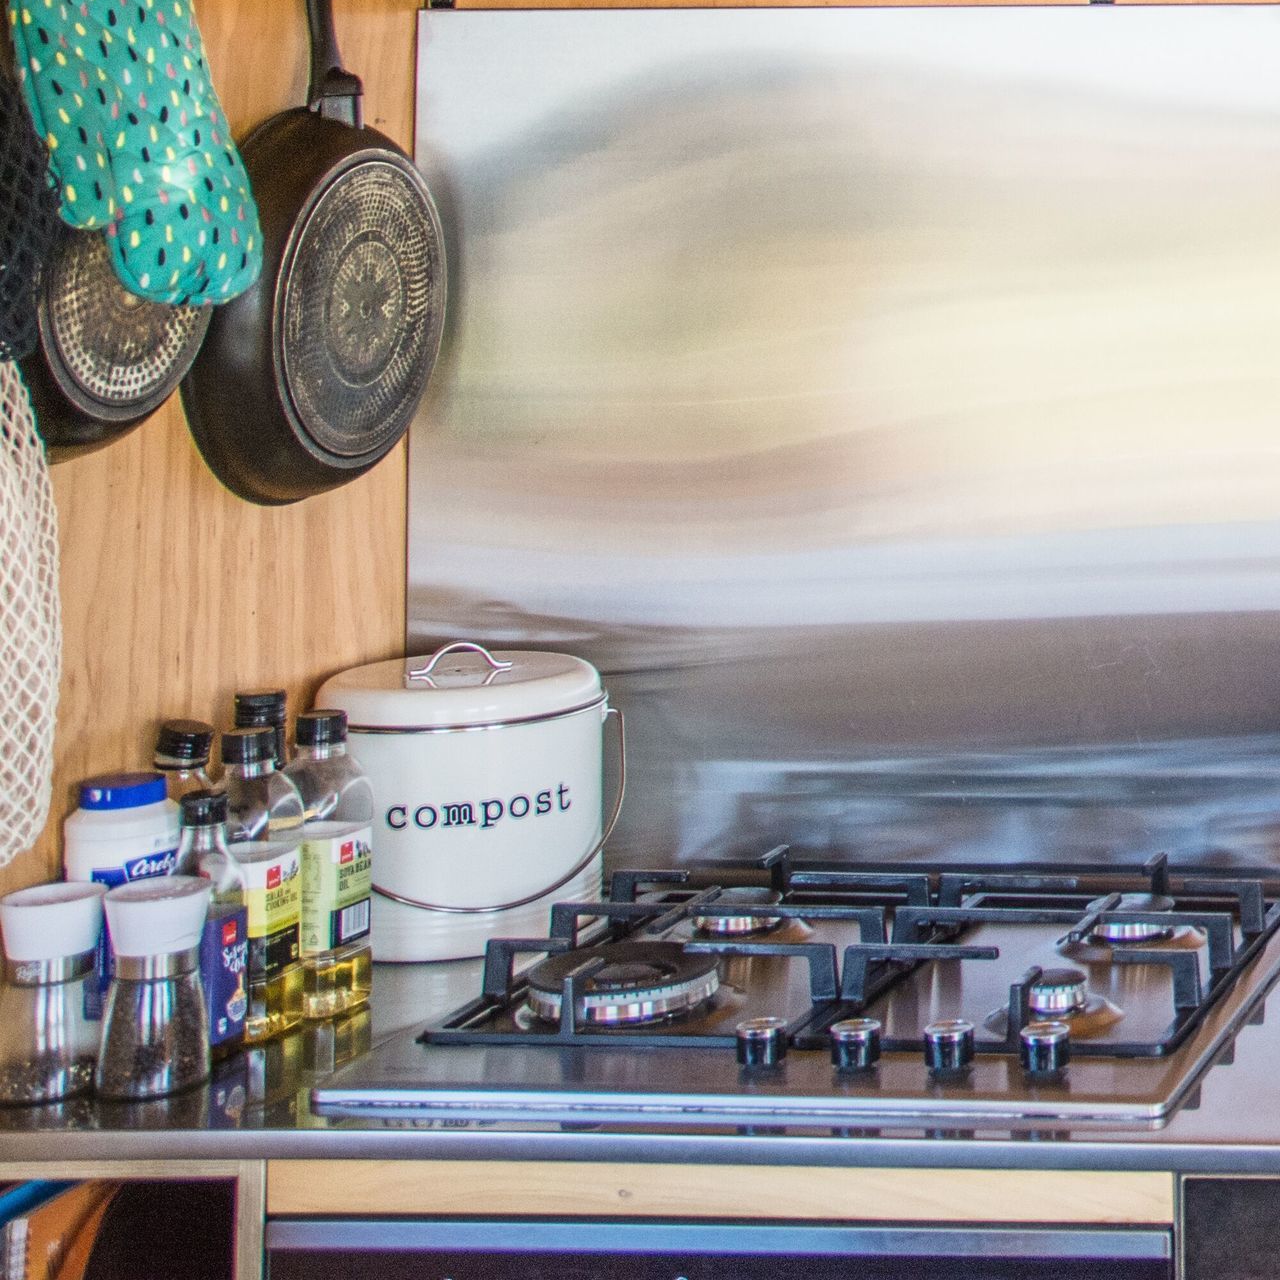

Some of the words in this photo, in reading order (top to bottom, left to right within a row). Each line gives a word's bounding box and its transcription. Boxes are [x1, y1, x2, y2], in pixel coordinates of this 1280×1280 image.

[386, 781, 572, 830] compost
[339, 865, 355, 879] SOYA
[355, 858, 372, 873] BEAN
[338, 879, 350, 892] OIL
[265, 897, 290, 912] COOKING
